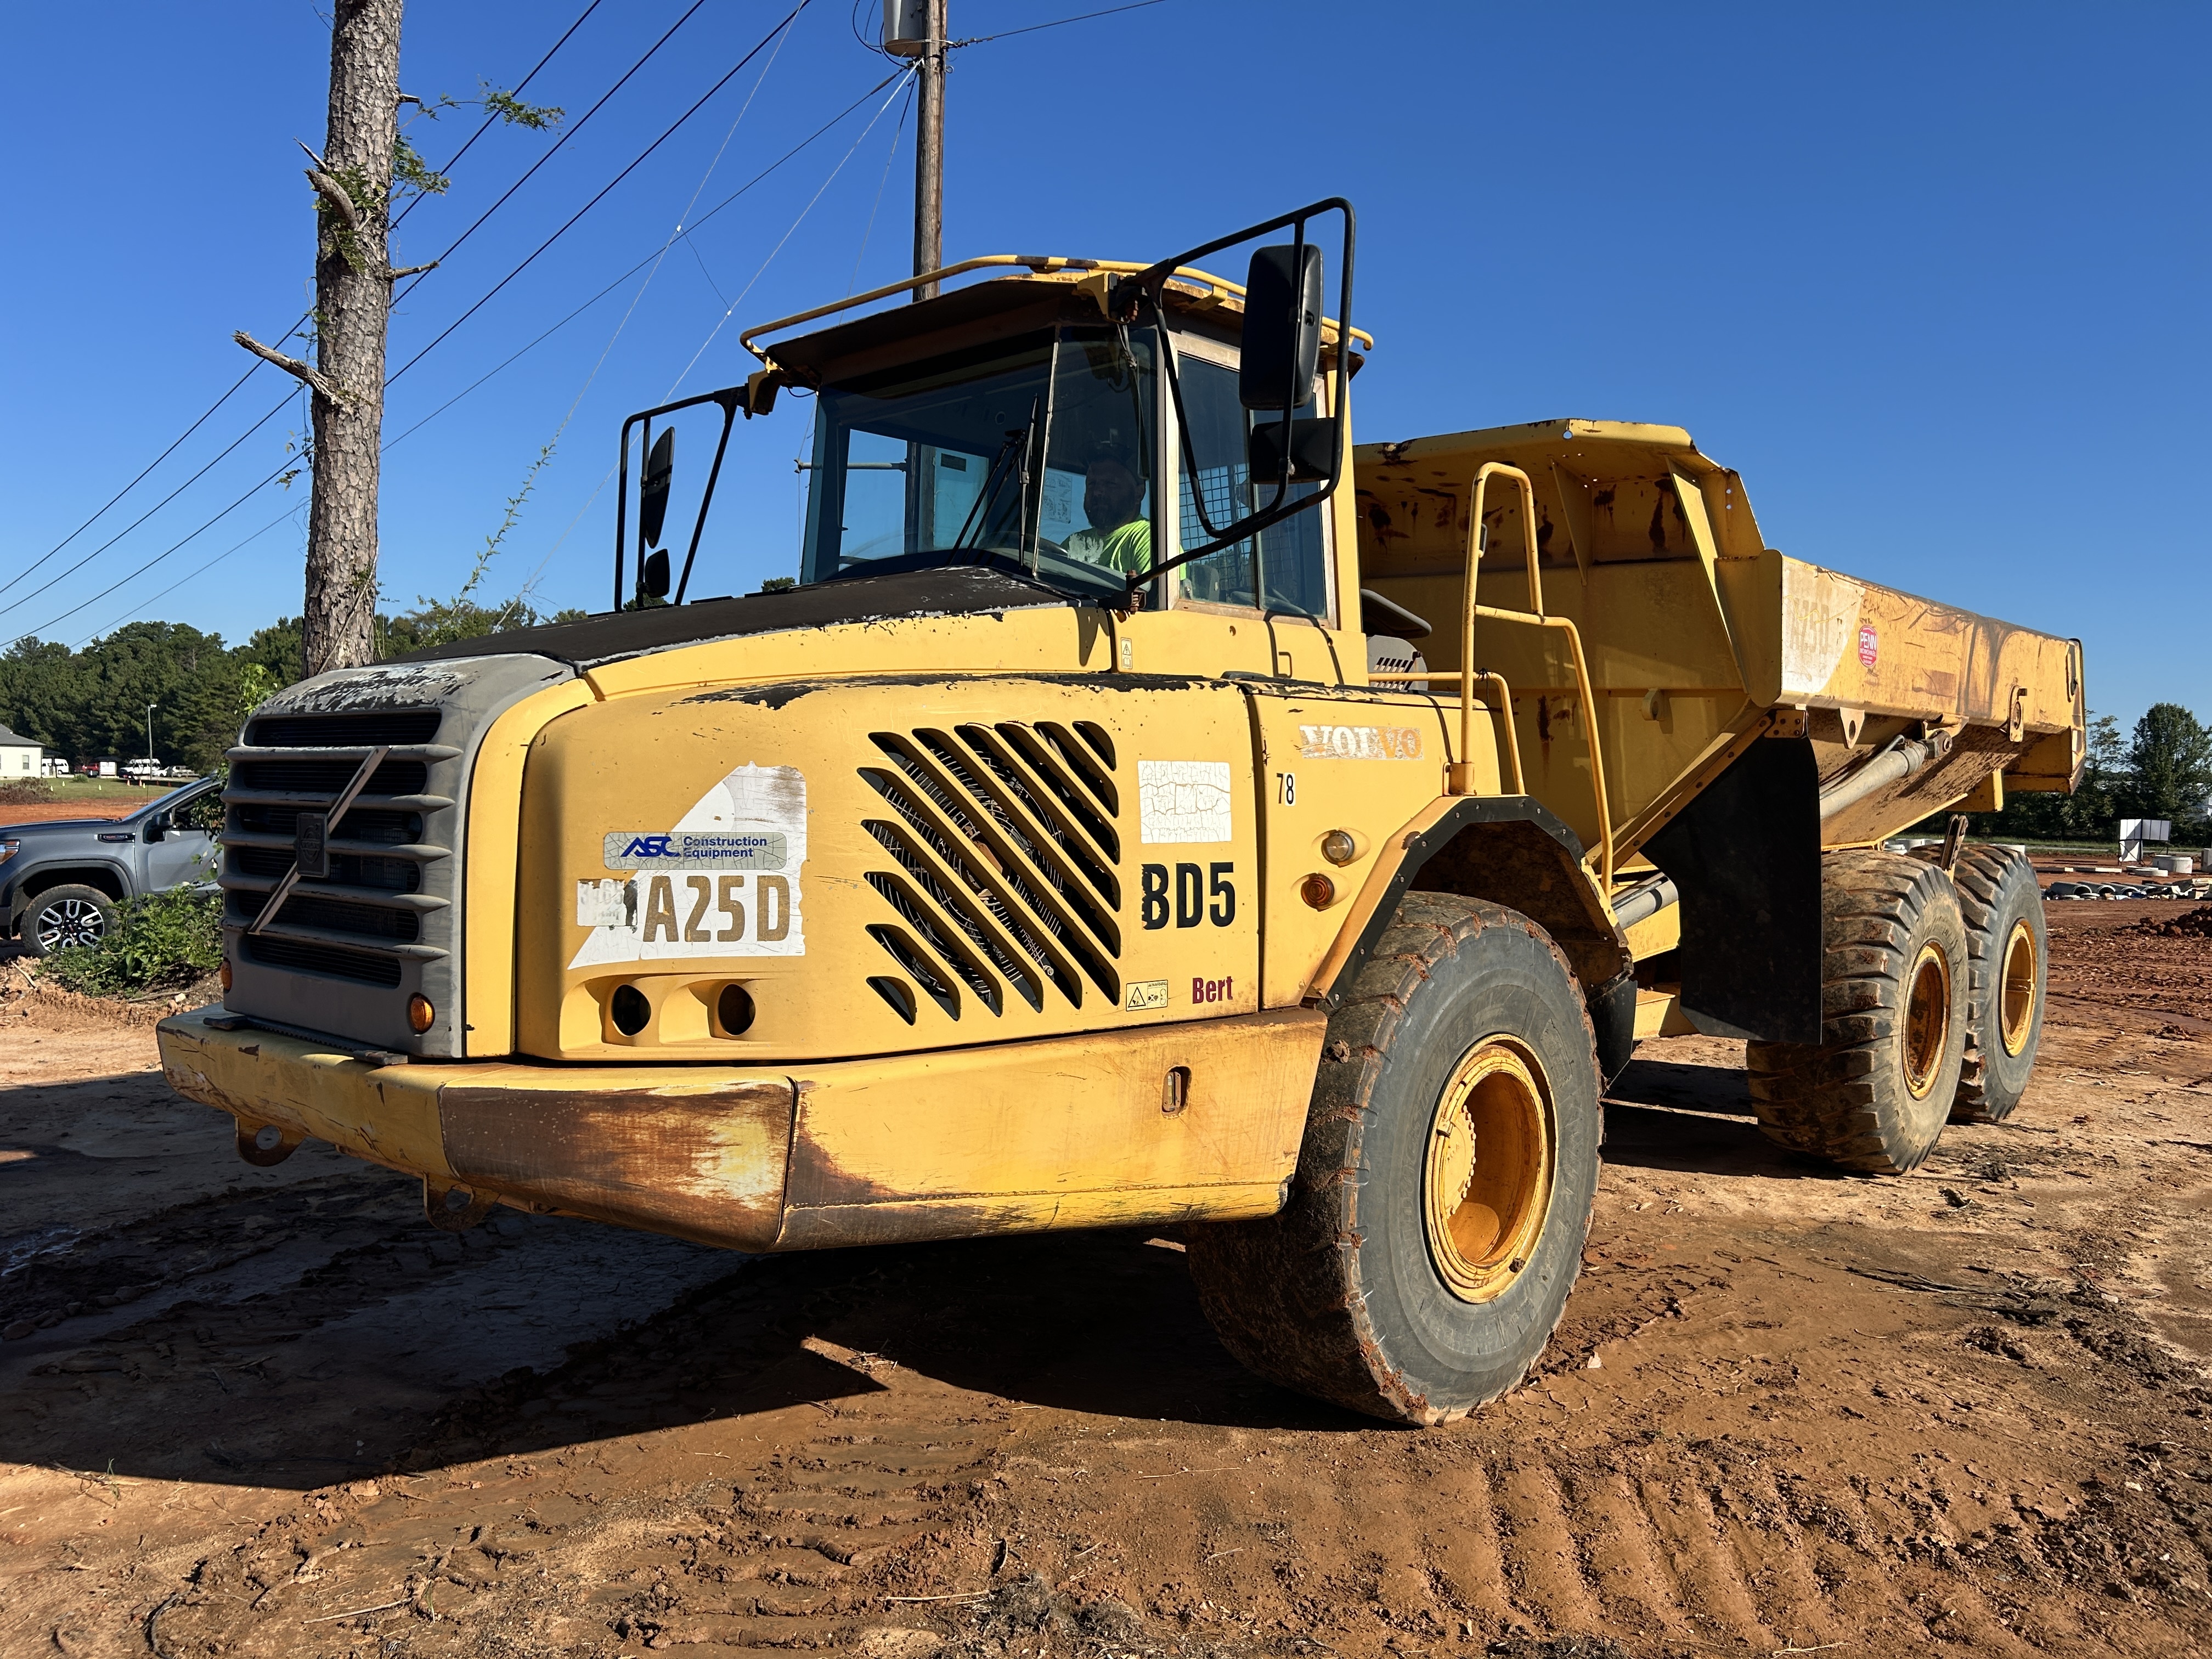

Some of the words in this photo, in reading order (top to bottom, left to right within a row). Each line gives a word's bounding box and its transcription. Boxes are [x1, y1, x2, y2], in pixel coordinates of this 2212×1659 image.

[1860, 631, 1877, 651] PENN
[1276, 772, 1294, 805] 78
[620, 836, 682, 857] ASC
[684, 836, 767, 846] Construction
[684, 848, 753, 859] Equipment
[643, 876, 790, 943] A25D
[1142, 861, 1235, 930] BD5
[1192, 975, 1233, 1005] Bert
